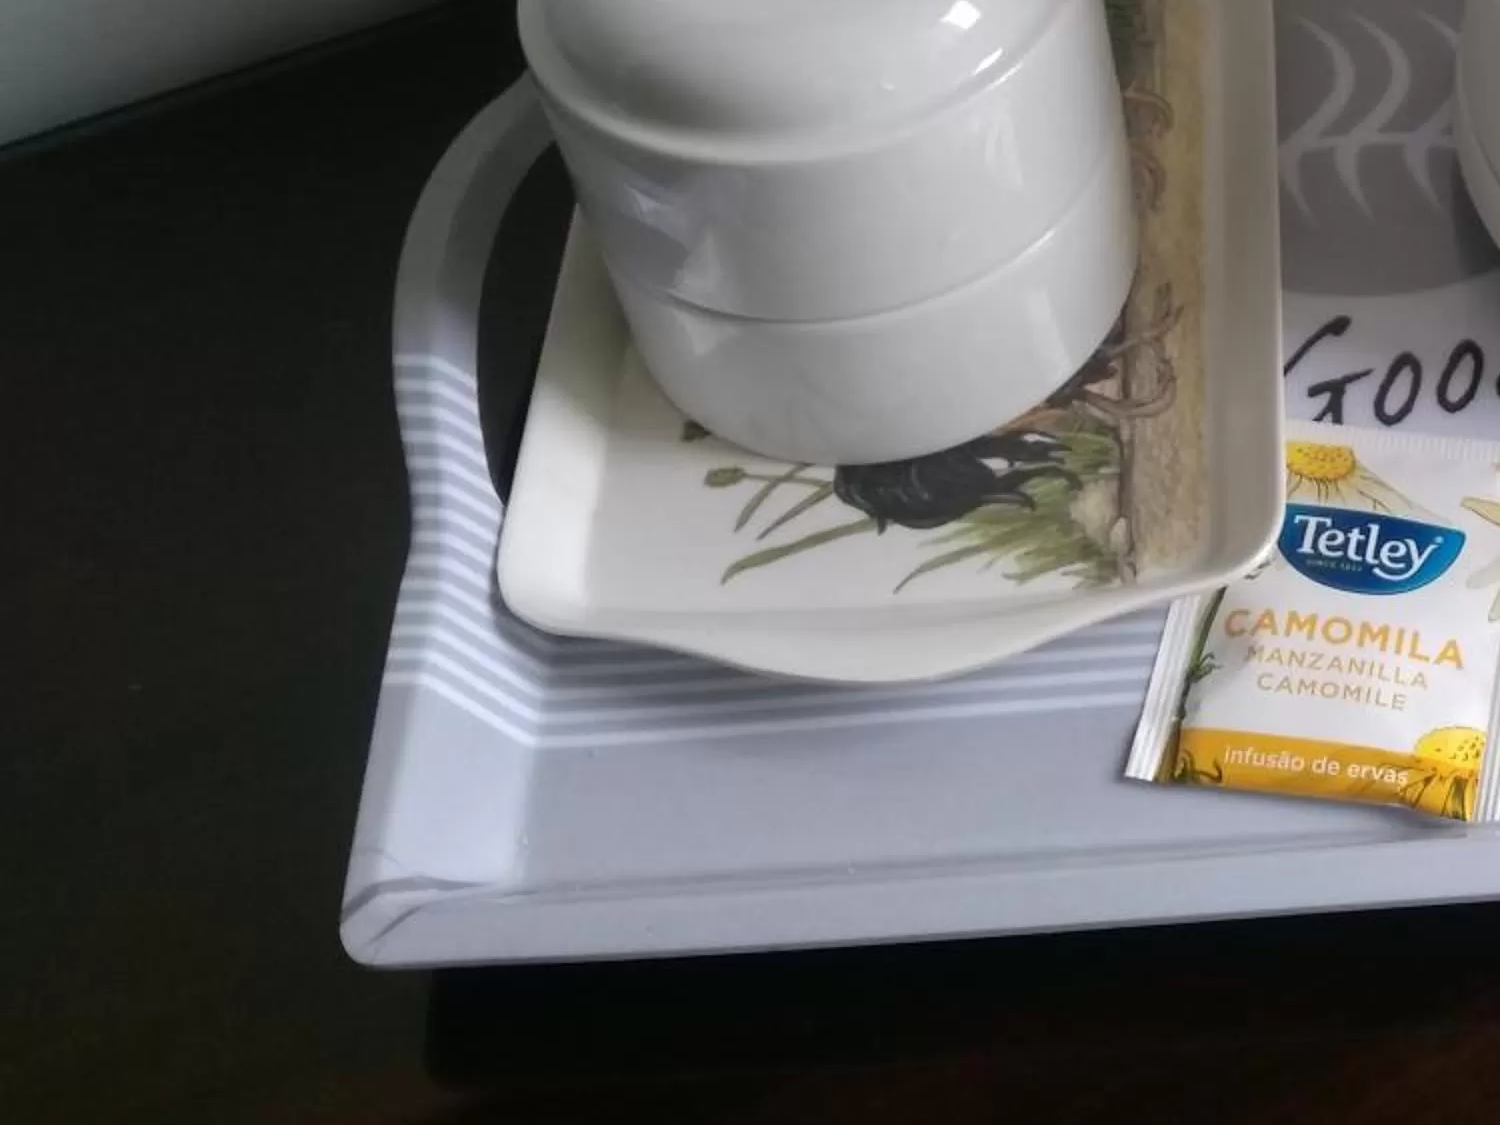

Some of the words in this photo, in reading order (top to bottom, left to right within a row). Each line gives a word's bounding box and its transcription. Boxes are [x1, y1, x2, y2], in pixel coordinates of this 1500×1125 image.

[1293, 514, 1444, 580] Tetley
[1224, 607, 1465, 670] CAMOMILA
[1244, 644, 1429, 691] MANZANILLA
[1256, 672, 1408, 712] CAMOMILE
[1223, 745, 1306, 773] infusão
[1311, 754, 1342, 777] de
[1347, 762, 1409, 786] ervas
